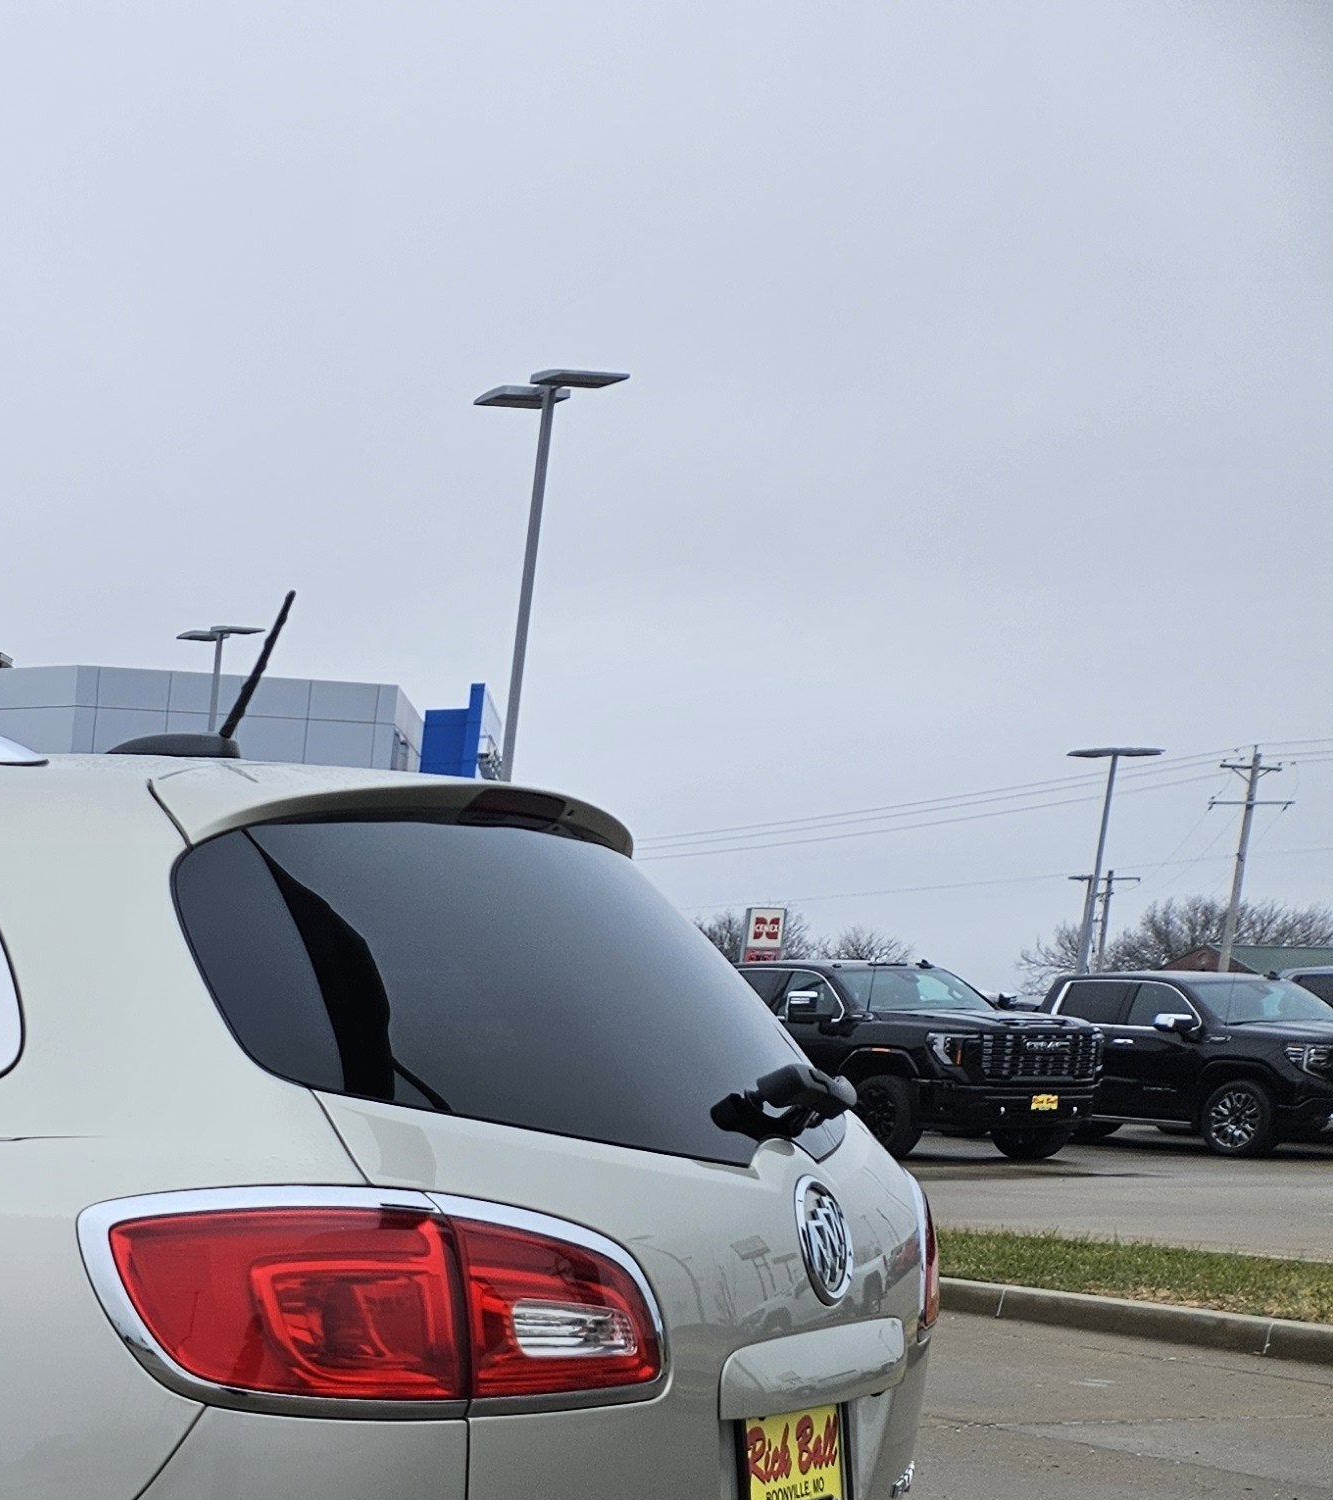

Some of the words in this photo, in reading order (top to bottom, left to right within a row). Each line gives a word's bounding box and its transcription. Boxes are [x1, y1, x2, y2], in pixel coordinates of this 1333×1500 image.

[746, 1423, 792, 1485] Rick
[796, 1414, 838, 1475] Ball
[812, 1476, 825, 1493] MO
